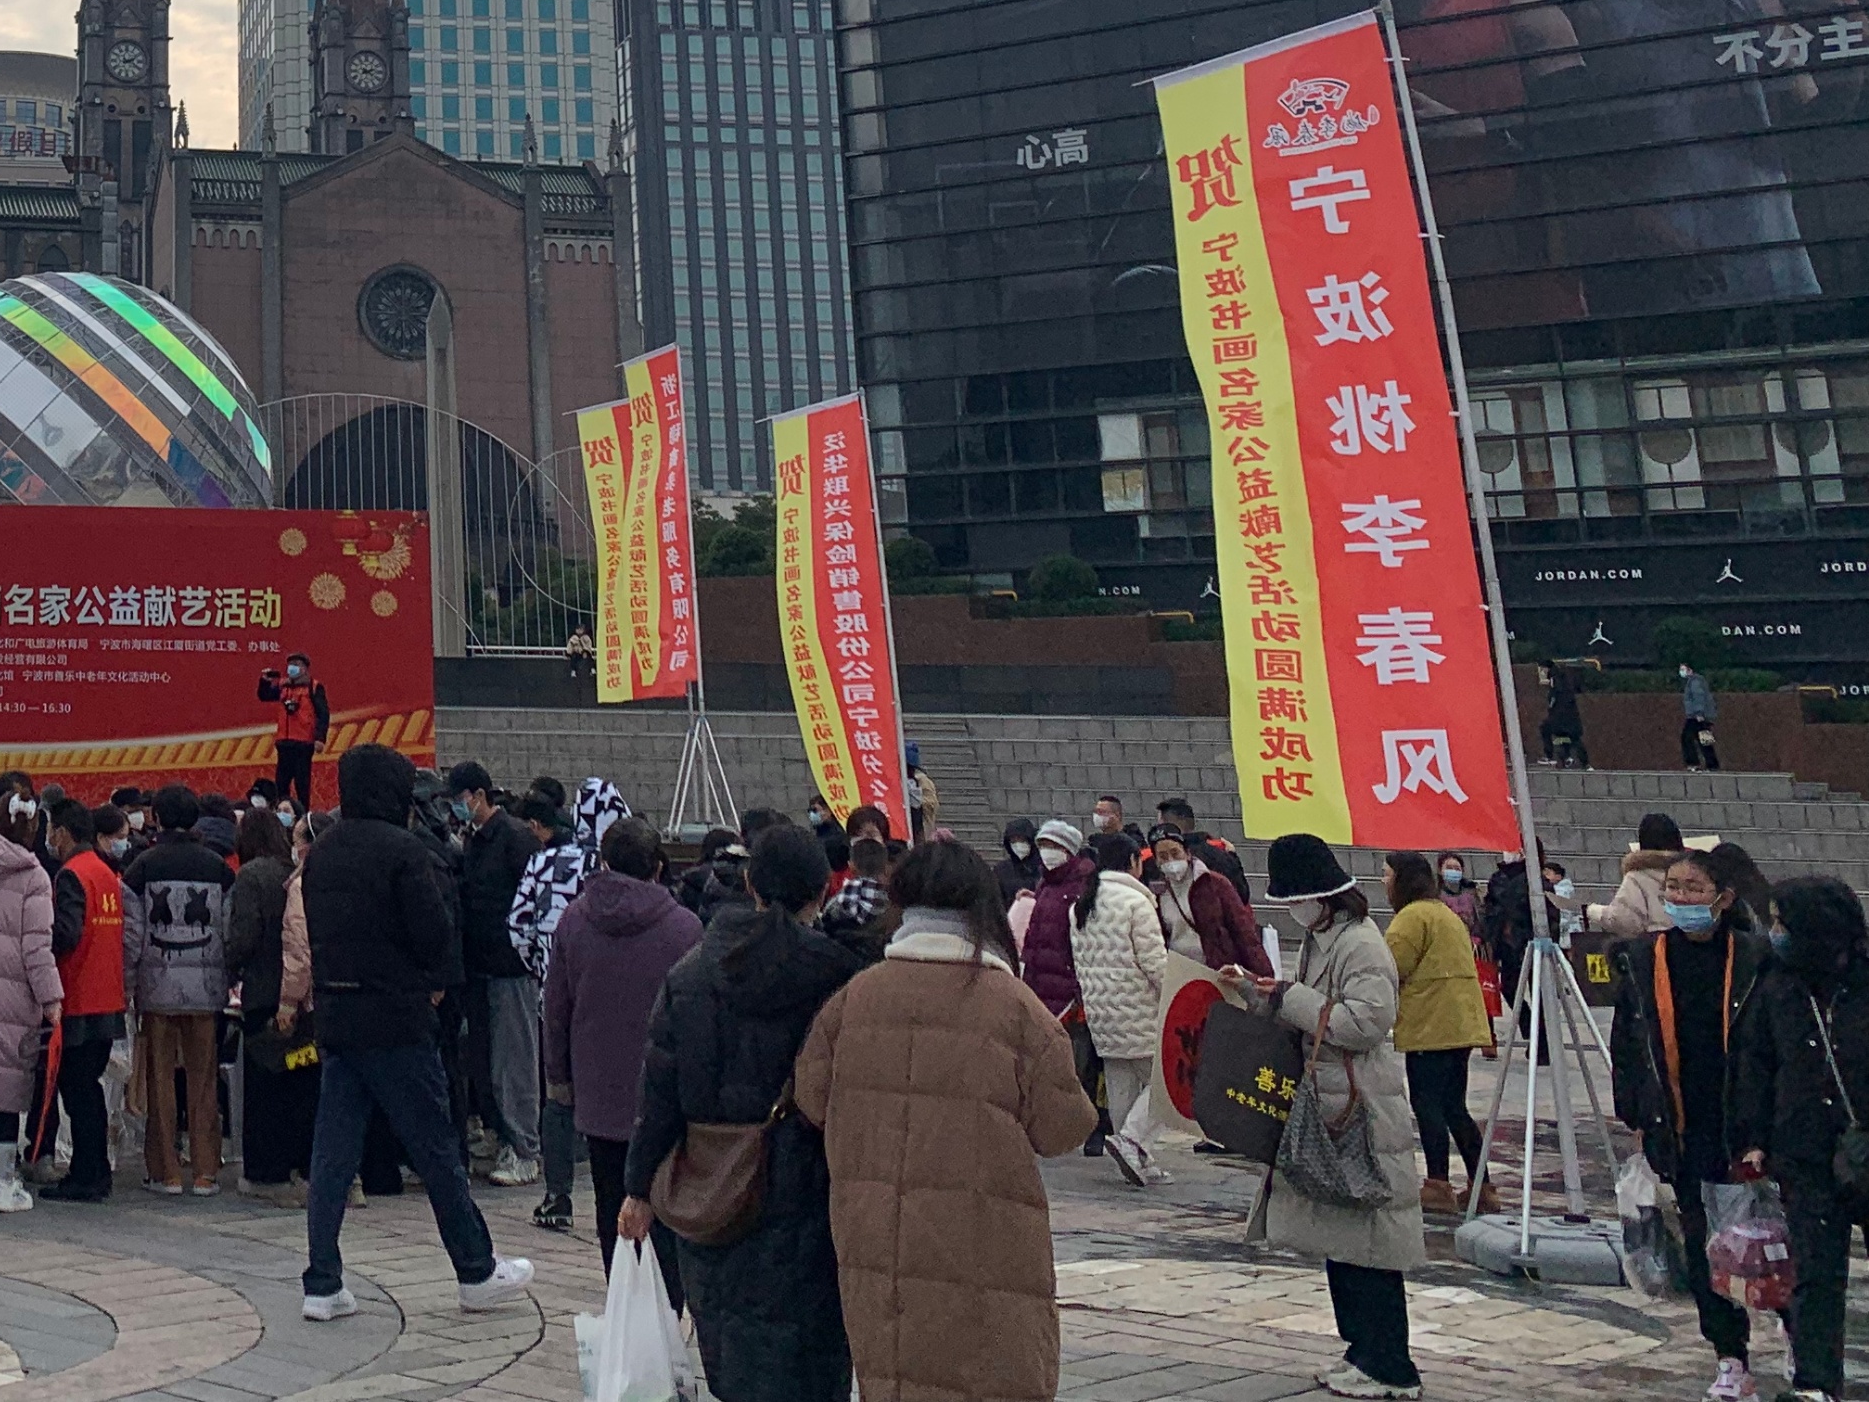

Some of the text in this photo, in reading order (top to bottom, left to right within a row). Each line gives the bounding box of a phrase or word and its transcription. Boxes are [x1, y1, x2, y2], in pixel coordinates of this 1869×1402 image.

[1713, 17, 1869, 73] 不分主
[1016, 128, 1089, 170] 心高
[1535, 568, 1644, 582] JORDAN.COM
[1255, 1065, 1297, 1101] 善乐
